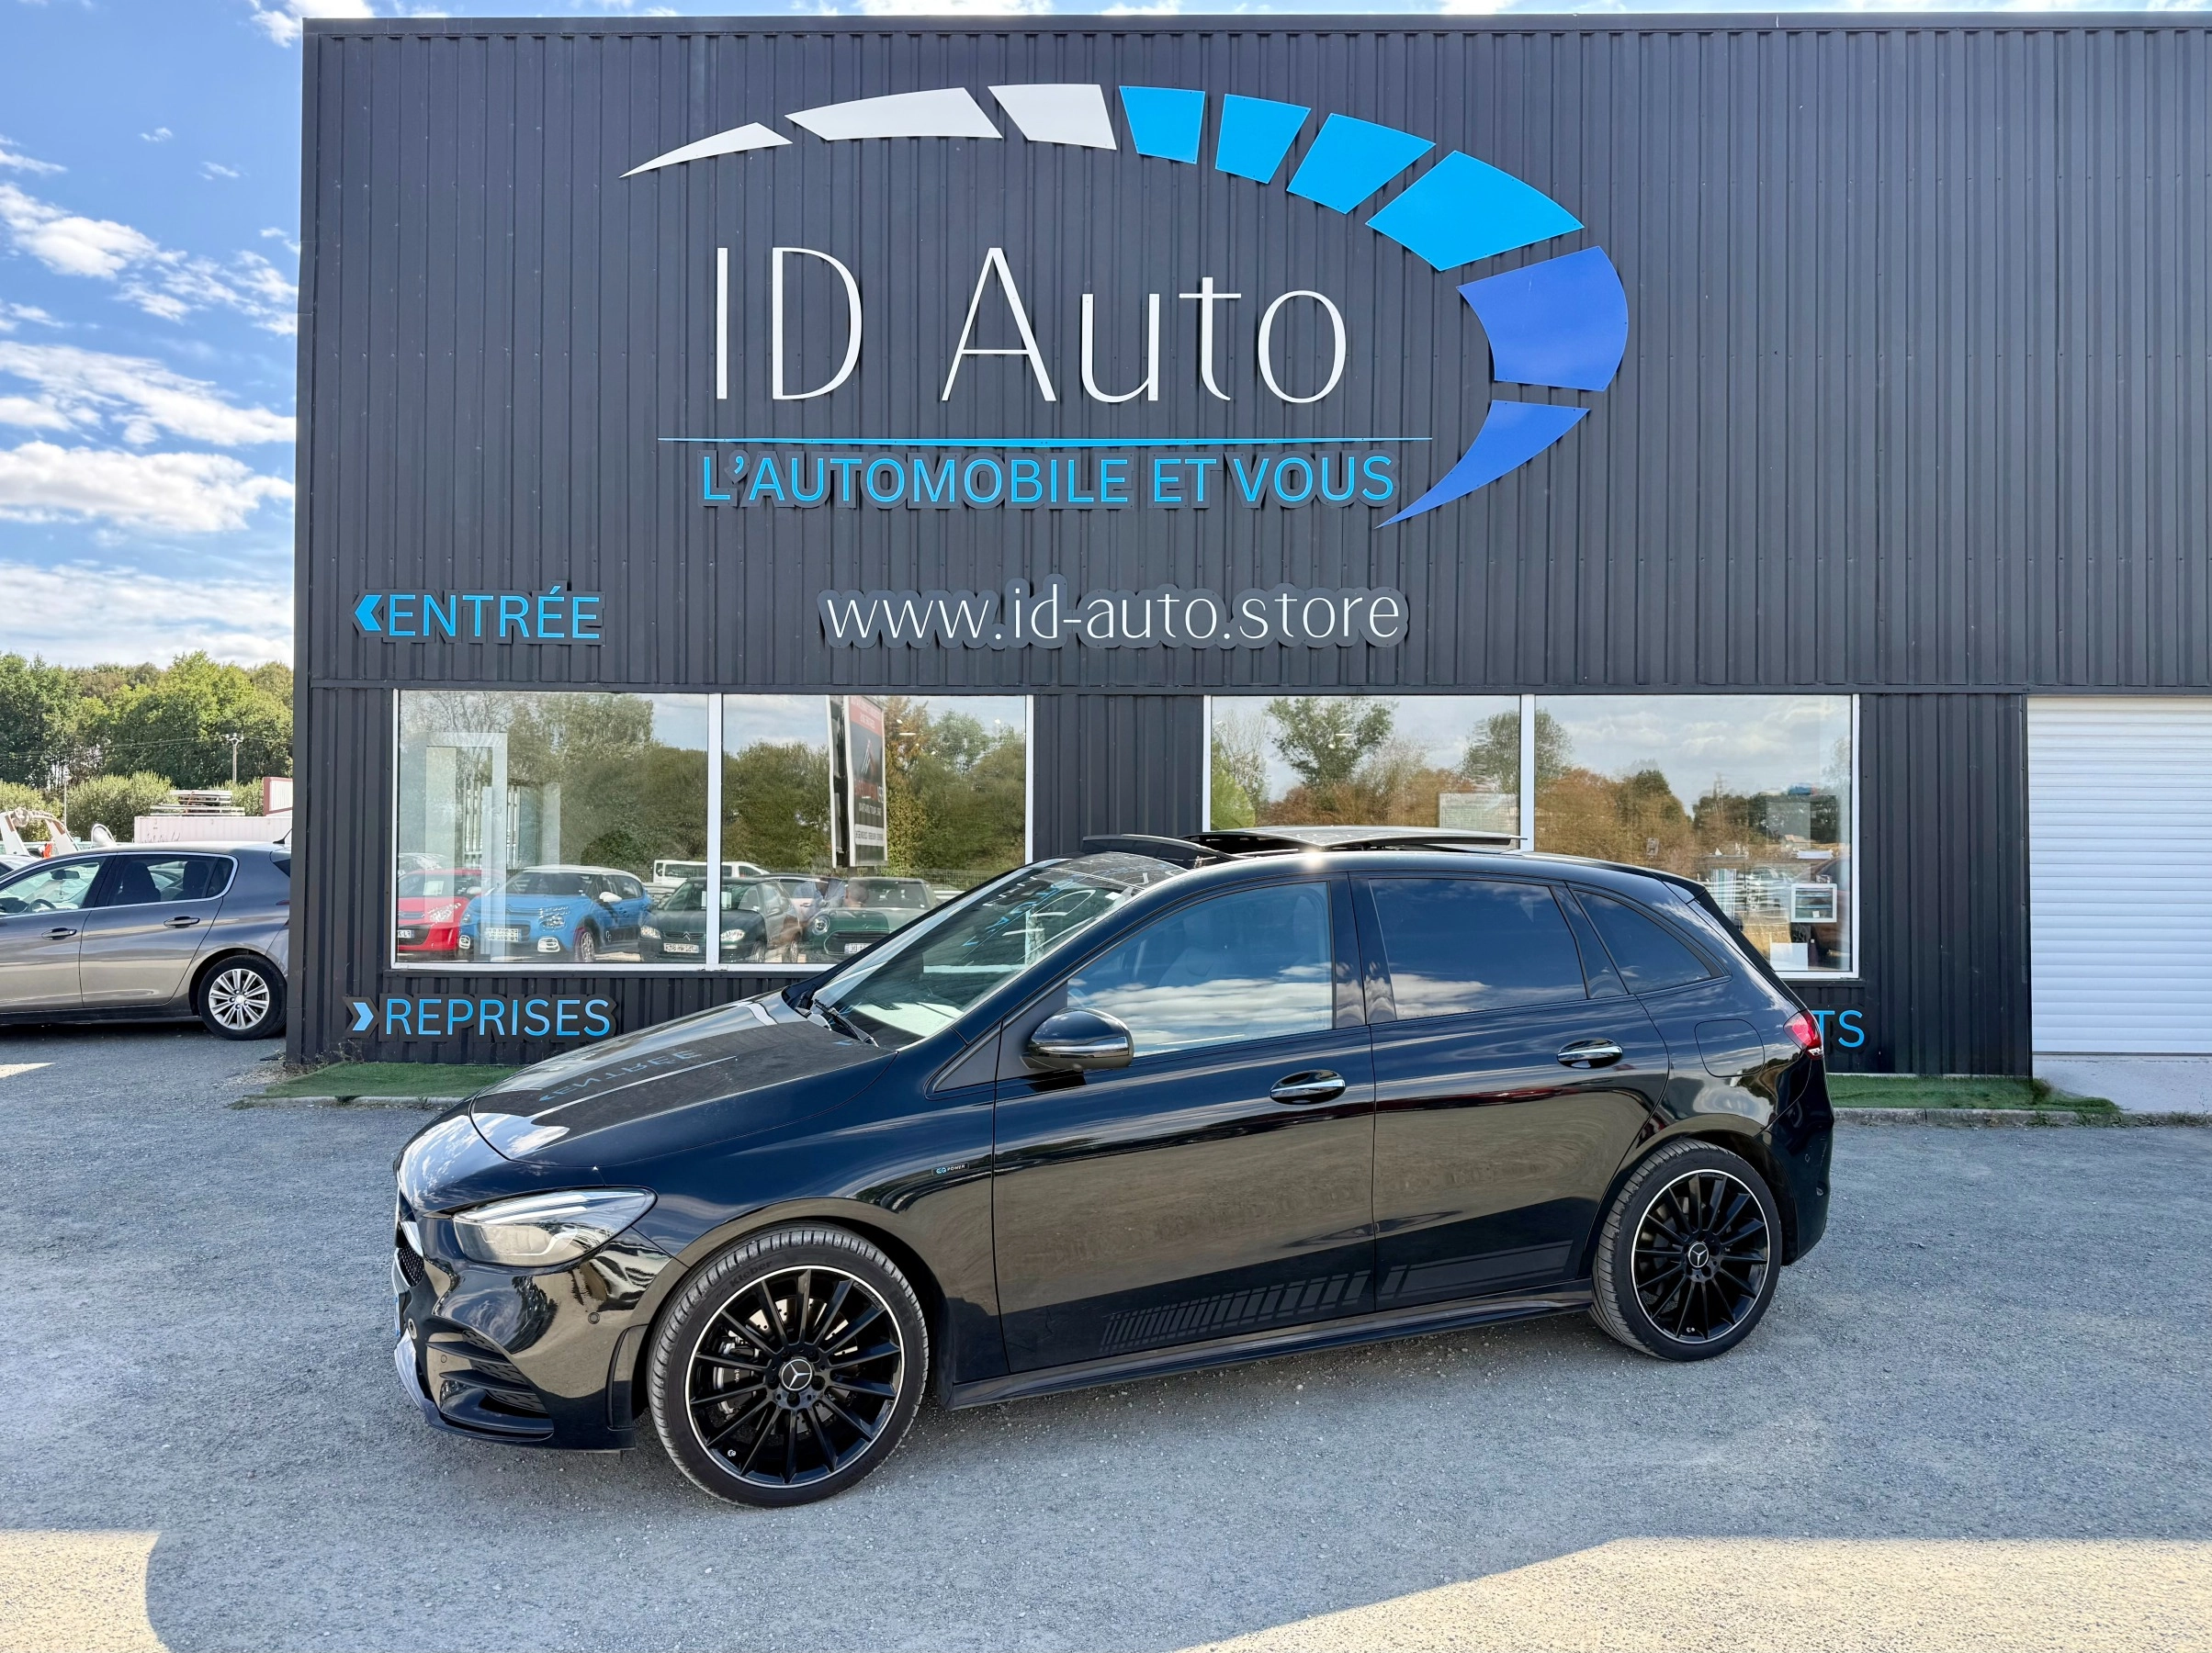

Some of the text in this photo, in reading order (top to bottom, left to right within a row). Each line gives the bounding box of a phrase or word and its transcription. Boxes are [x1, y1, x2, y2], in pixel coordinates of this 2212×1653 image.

[717, 246, 1348, 403] ID Auto
[1154, 457, 1217, 503] ET
[1233, 454, 1395, 503] VOUS
[388, 585, 600, 638] ENTRÉE
[826, 583, 1400, 640] www.id-auto.store
[385, 998, 611, 1037] REPRISES
[729, 1261, 772, 1288] Kleber
